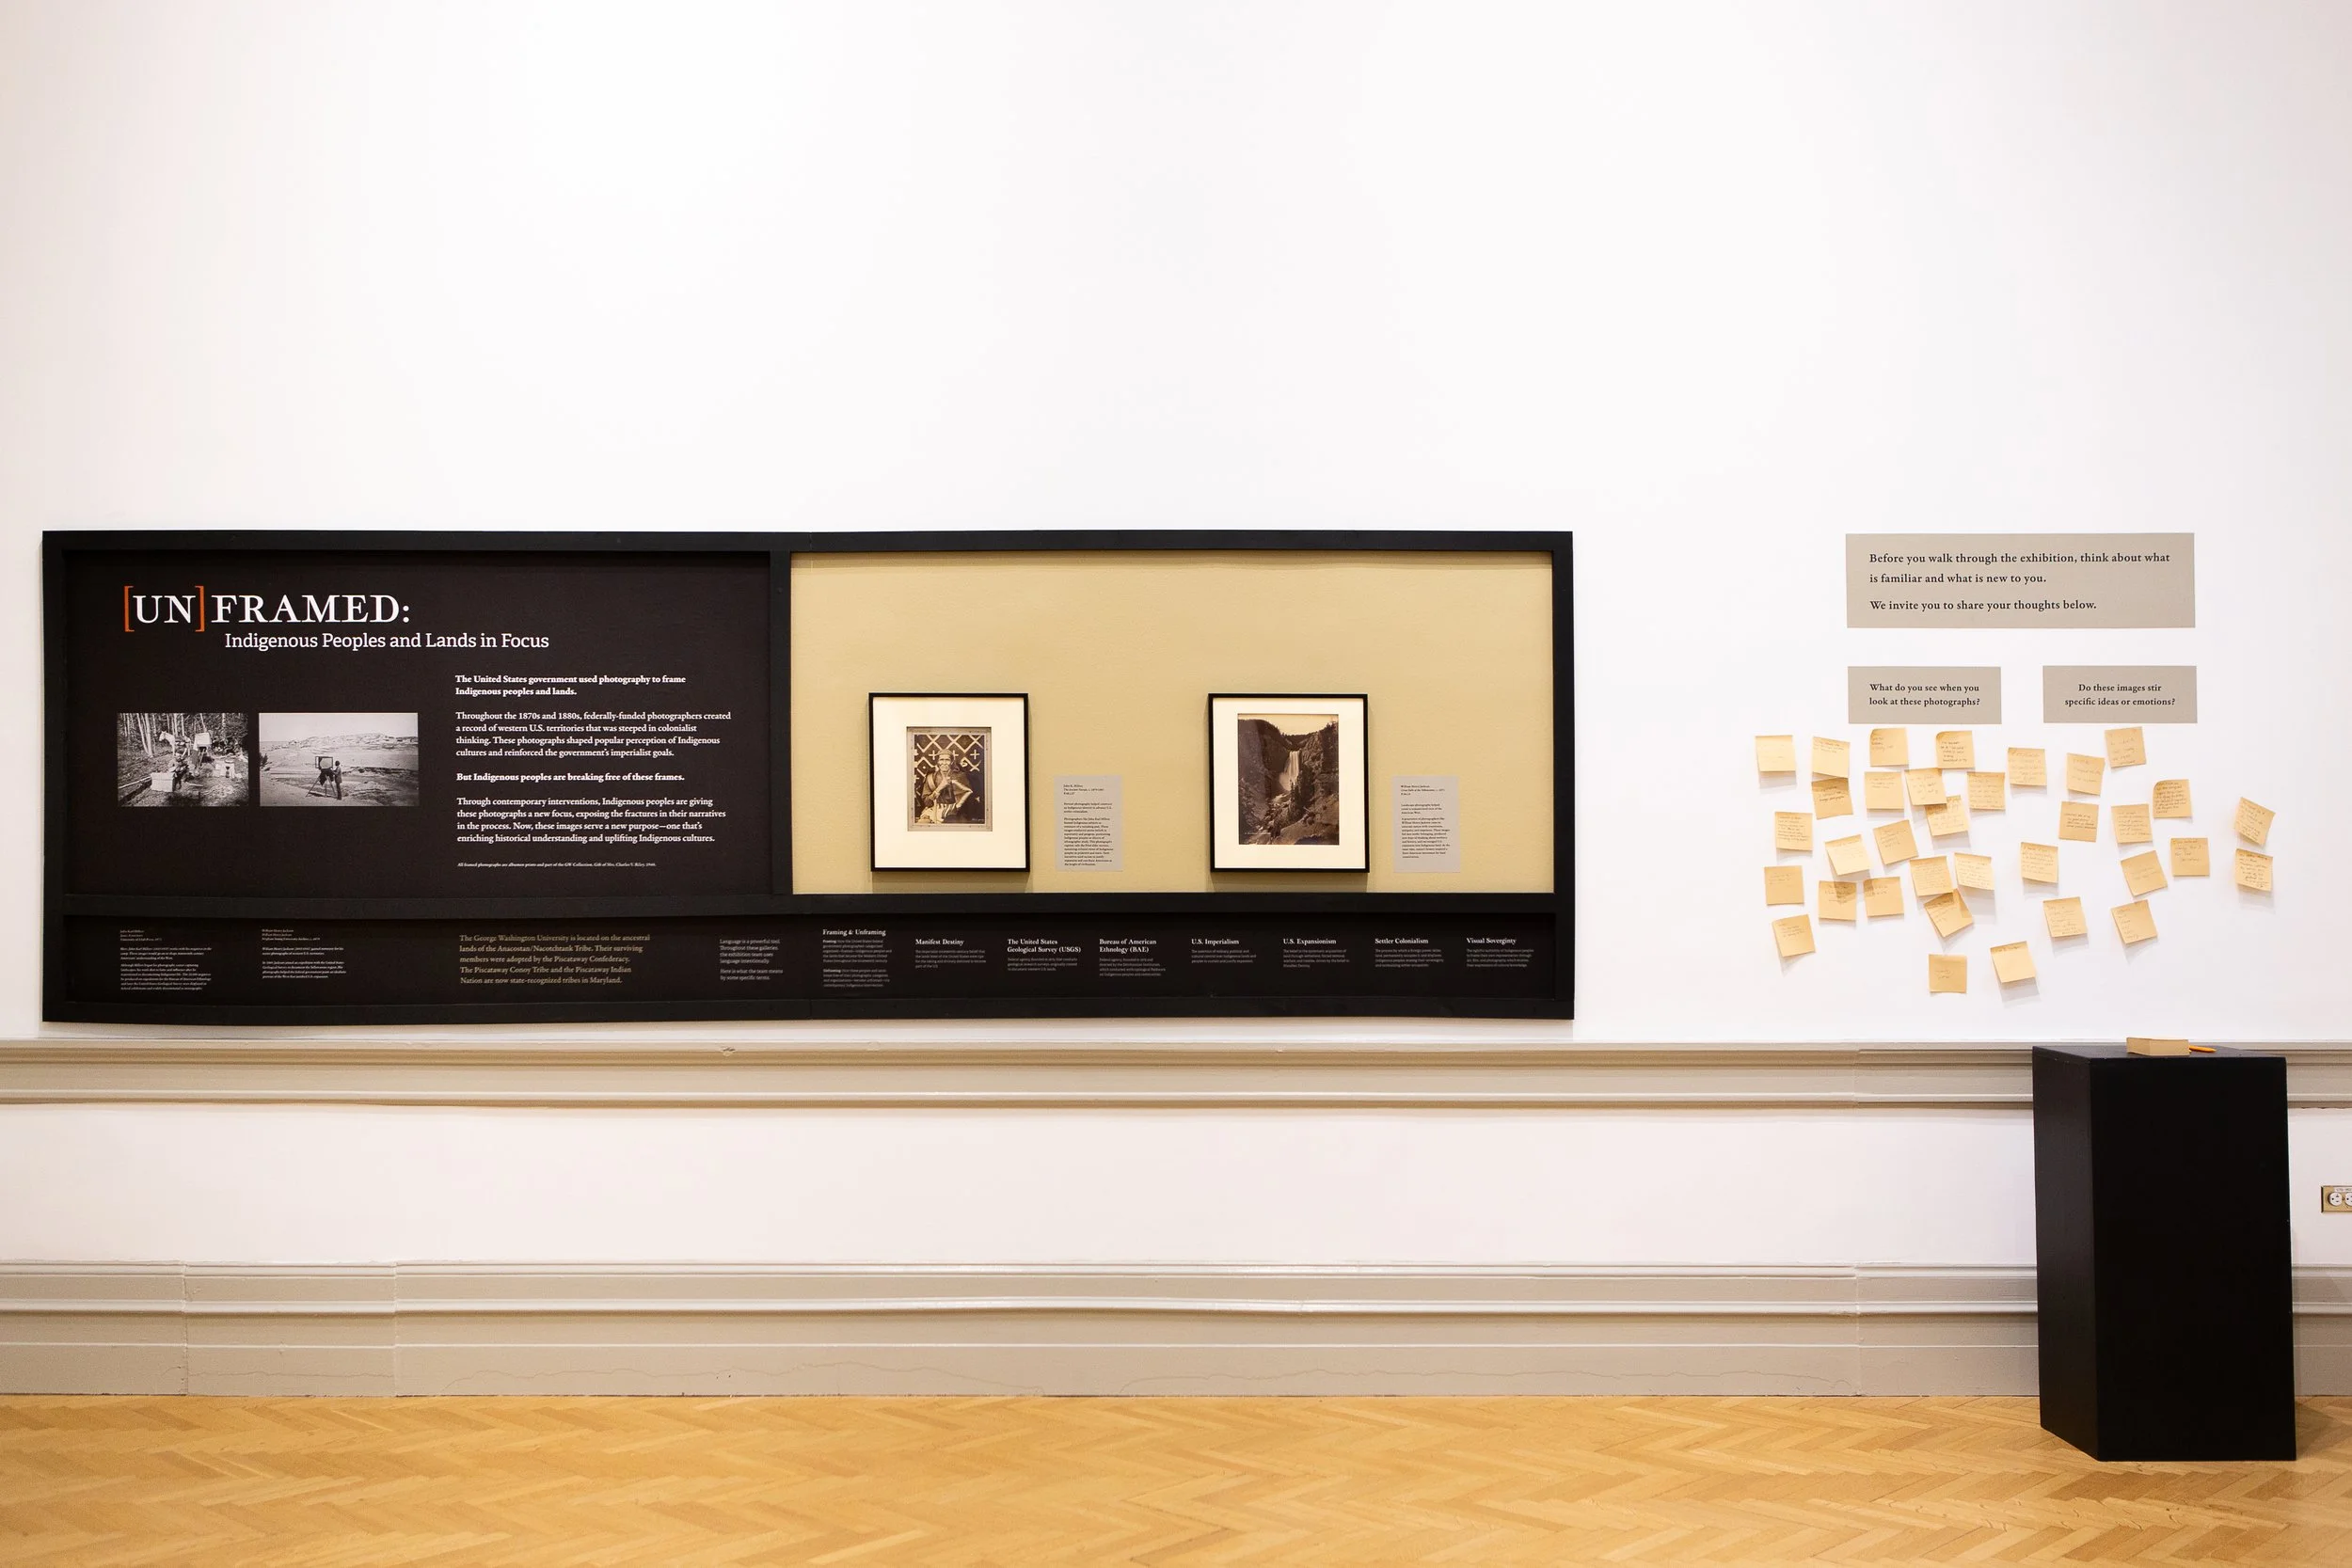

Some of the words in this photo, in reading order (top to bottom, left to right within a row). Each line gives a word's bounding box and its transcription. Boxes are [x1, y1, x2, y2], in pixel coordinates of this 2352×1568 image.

[1869, 553, 1904, 562] Before
[1906, 556, 1926, 565] you
[1928, 553, 1953, 562] walk
[1955, 553, 1997, 565] through
[2000, 553, 2017, 562] the
[2020, 553, 2077, 563] exhibition,
[2080, 552, 2109, 562] think
[2111, 552, 2142, 562] about
[2144, 552, 2170, 562] what
[1869, 573, 1878, 583] is
[1881, 573, 1923, 583] familiar
[1925, 573, 1945, 583] and
[1947, 573, 1973, 583] what
[1975, 573, 1983, 583] is
[2024, 576, 2046, 585] you.
[1869, 600, 1886, 610] We
[1889, 600, 1918, 610] invite
[1921, 603, 1941, 612] you
[1957, 600, 1984, 610] share
[1986, 603, 2011, 612] your
[2013, 599, 2060, 612] thoughts
[2062, 599, 2097, 610] below.
[225, 632, 318, 652] Indigenous
[322, 632, 386, 652] Peoples
[389, 632, 421, 648] and
[425, 632, 477, 648] Lands
[480, 632, 498, 648] in
[501, 633, 549, 648] Focus
[454, 674, 472, 683] The
[473, 674, 502, 683] United
[502, 674, 528, 683] States
[528, 676, 578, 686] government
[578, 674, 598, 683] used
[598, 674, 651, 686] photography
[661, 674, 686, 683] frame
[455, 687, 501, 698] Indigenous
[502, 687, 534, 697] peoples
[534, 687, 551, 695] and
[552, 687, 578, 695] lands.
[1869, 683, 1893, 691] What
[1895, 683, 1906, 691] do
[1939, 683, 1963, 691] when
[1963, 686, 1979, 694] you
[2093, 683, 2115, 691] these
[2117, 684, 2146, 694] images
[1869, 697, 1888, 705] look
[1899, 697, 1922, 705] these
[1923, 697, 1980, 707] photographs?
[2065, 697, 2096, 707] specific
[2098, 697, 2120, 705] ideas
[2132, 697, 2176, 705] emotions?
[455, 711, 503, 722] Throughout
[503, 711, 517, 720] the
[541, 711, 557, 720] and
[558, 712, 582, 721] 1880s,
[583, 711, 646, 721] federally-funded
[646, 711, 703, 722] photographers
[703, 711, 732, 720] created
[456, 772, 472, 781] But
[473, 772, 519, 784] Indigenous
[520, 772, 552, 783] peoples
[567, 772, 605, 784] breaking
[604, 772, 621, 781] free
[622, 772, 632, 781] of
[631, 772, 654, 781] these
[654, 772, 685, 781] frames.
[456, 833, 495, 845] enriching
[495, 833, 532, 842] historical
[532, 833, 588, 845] understanding
[588, 833, 604, 842] and
[604, 833, 638, 845] uplifting
[639, 833, 681, 845] Indigenous
[682, 833, 715, 842] cultures.
[822, 928, 848, 937] Framing
[855, 928, 886, 937] Unframing
[473, 935, 497, 943] George
[498, 934, 536, 943] Washington
[536, 934, 569, 942] University
[1296, 938, 1337, 946] Expansionism
[613, 944, 644, 953] surviving
[1099, 946, 1129, 955] Ethnology
[506, 955, 532, 964] adopted
[532, 955, 542, 964] by
[553, 955, 589, 964] Piscataway
[589, 955, 630, 964] Confederacy.
[474, 966, 509, 974] Piscataway
[509, 966, 532, 974] Conoy
[575, 966, 610, 974] Piscataway
[510, 976, 562, 986] state-recognized
[589, 976, 623, 985] Maryland.
